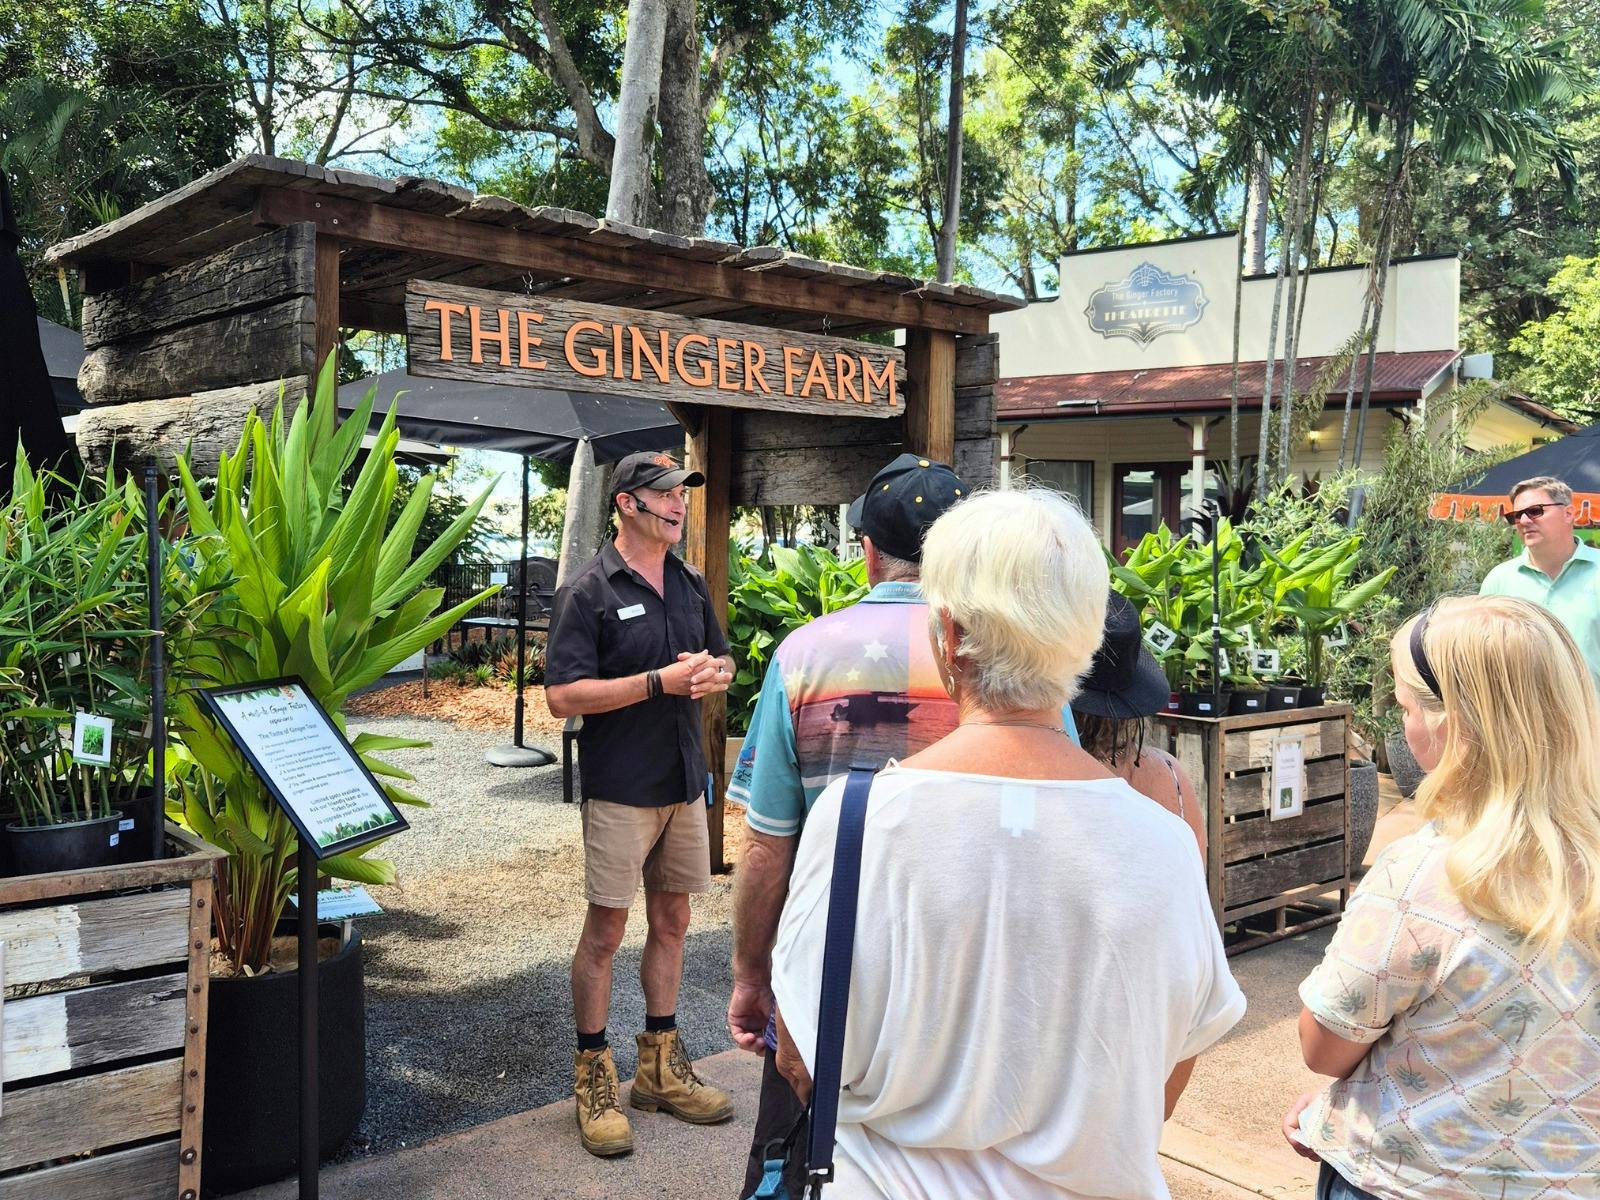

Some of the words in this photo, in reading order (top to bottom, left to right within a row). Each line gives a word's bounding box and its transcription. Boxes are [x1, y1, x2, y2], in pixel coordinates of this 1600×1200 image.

[1112, 292, 1124, 300] The
[1126, 290, 1149, 300] Ginger
[1151, 288, 1178, 297] Factory
[424, 300, 548, 369] THE
[563, 320, 772, 394] GINGER
[782, 346, 898, 406] FARM
[269, 705, 287, 714] Ginger
[288, 702, 307, 710] Factory
